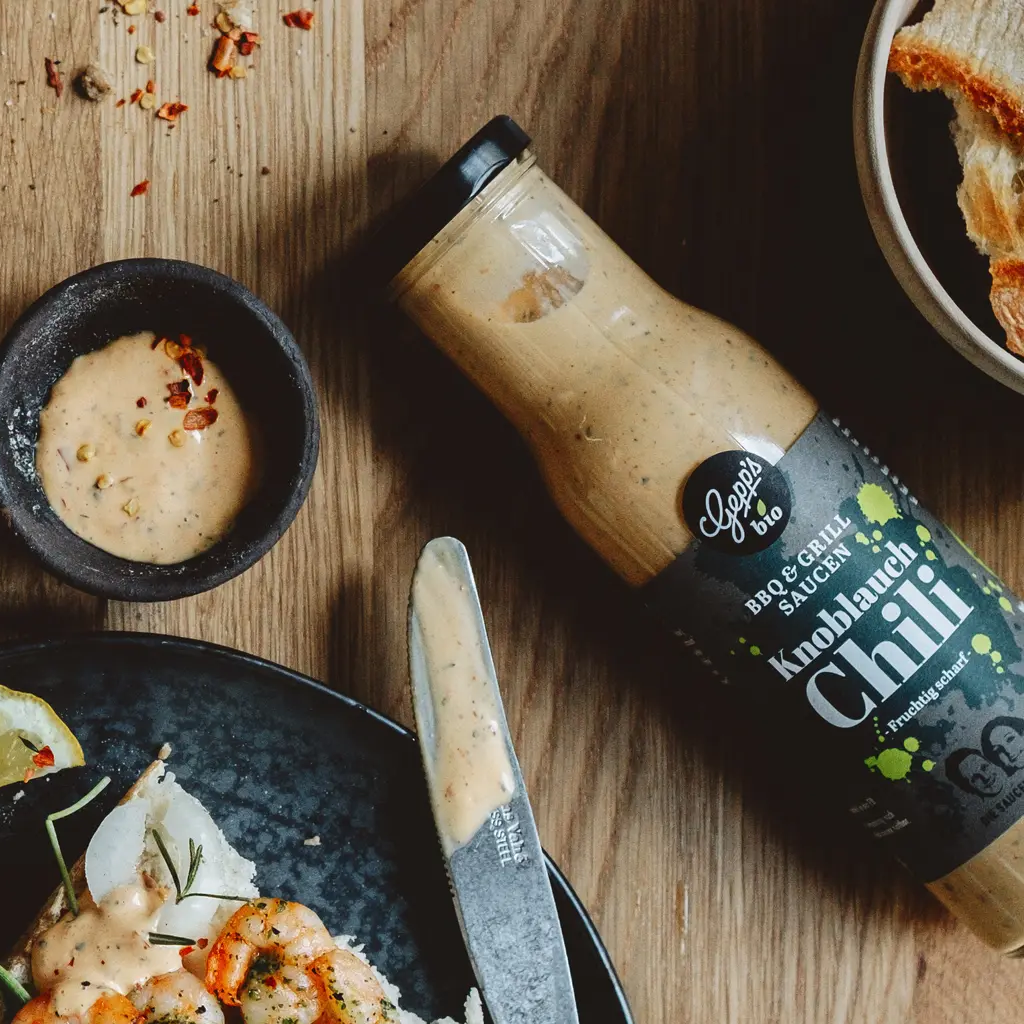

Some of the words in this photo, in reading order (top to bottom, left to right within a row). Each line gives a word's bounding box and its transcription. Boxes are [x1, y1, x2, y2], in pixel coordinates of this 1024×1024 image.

[699, 456, 763, 544] Gepp's
[749, 505, 784, 537] bio
[744, 578, 789, 616] BBQ
[781, 564, 798, 583] &
[797, 513, 852, 567] GRILL
[767, 538, 919, 682] Knoblauch
[778, 542, 852, 617] SAUCEN
[805, 564, 975, 729] Chili
